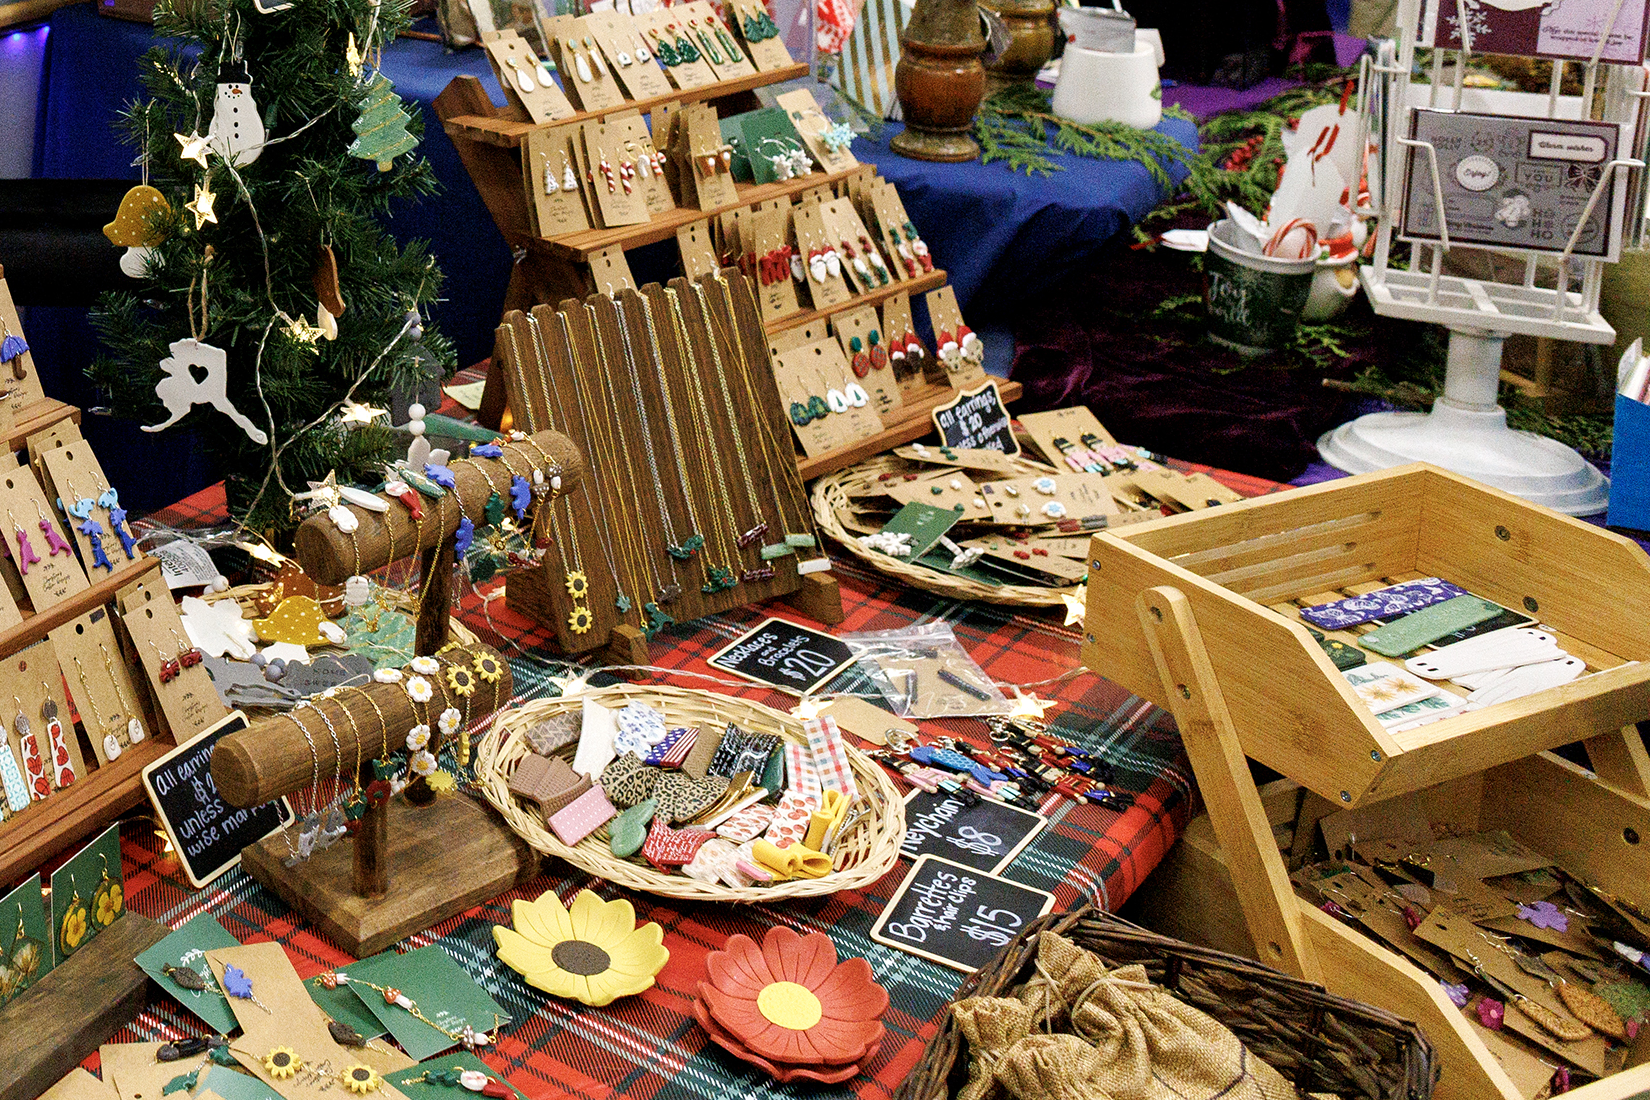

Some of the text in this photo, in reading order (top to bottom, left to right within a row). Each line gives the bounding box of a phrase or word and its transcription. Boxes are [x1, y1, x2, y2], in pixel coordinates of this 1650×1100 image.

[716, 632, 779, 669] Necklaces
[757, 635, 811, 667] Bracelets
[778, 649, 836, 682] $20
[177, 743, 215, 782] earrin
[191, 771, 218, 806] $2
[179, 797, 225, 840] unless
[900, 794, 966, 852] eychain
[187, 825, 221, 858] wise
[945, 825, 1003, 857] $8
[888, 870, 959, 943] Barrettes
[947, 876, 977, 905] clips
[959, 904, 1023, 947] $15
